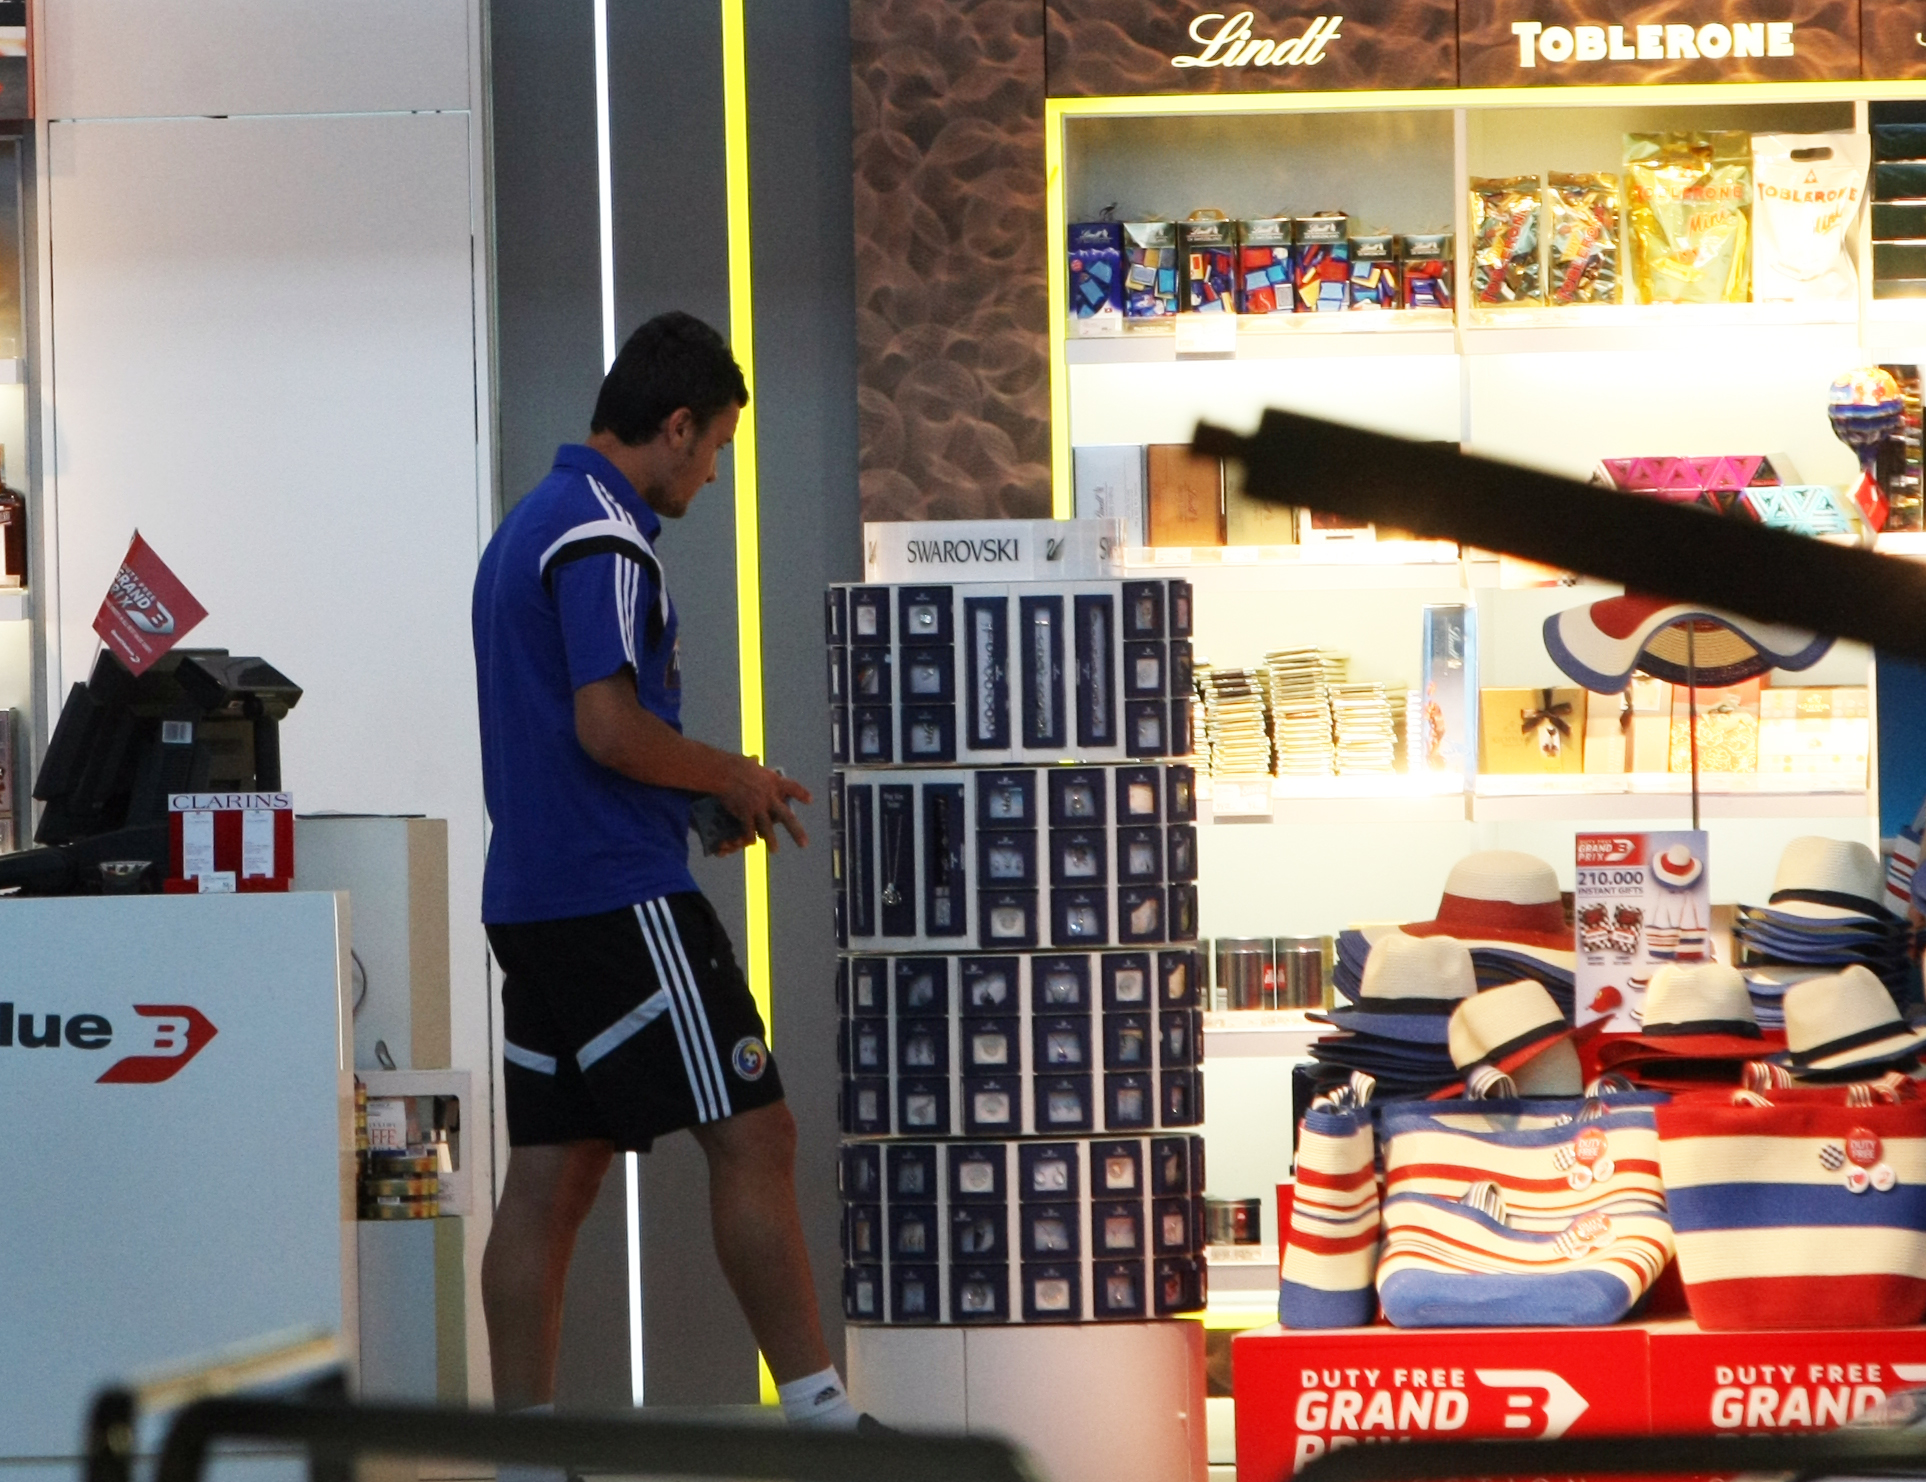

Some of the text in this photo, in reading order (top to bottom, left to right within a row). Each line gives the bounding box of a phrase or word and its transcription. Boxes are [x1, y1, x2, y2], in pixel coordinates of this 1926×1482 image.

[1171, 11, 1344, 67] Lindt
[1511, 22, 1794, 68] TOBLERONE
[907, 538, 1019, 564] SWAROVSKI
[172, 793, 289, 810] CLARINS
[1578, 844, 1613, 853] GRAND
[1578, 853, 1605, 861] PRIX
[1578, 871, 1644, 885] 210.000
[1578, 887, 1616, 895] INSTANT
[1301, 1368, 1466, 1388] DUTY FREE
[1715, 1363, 1883, 1385] DUTY FREE
[1295, 1389, 1470, 1432] GRAND
